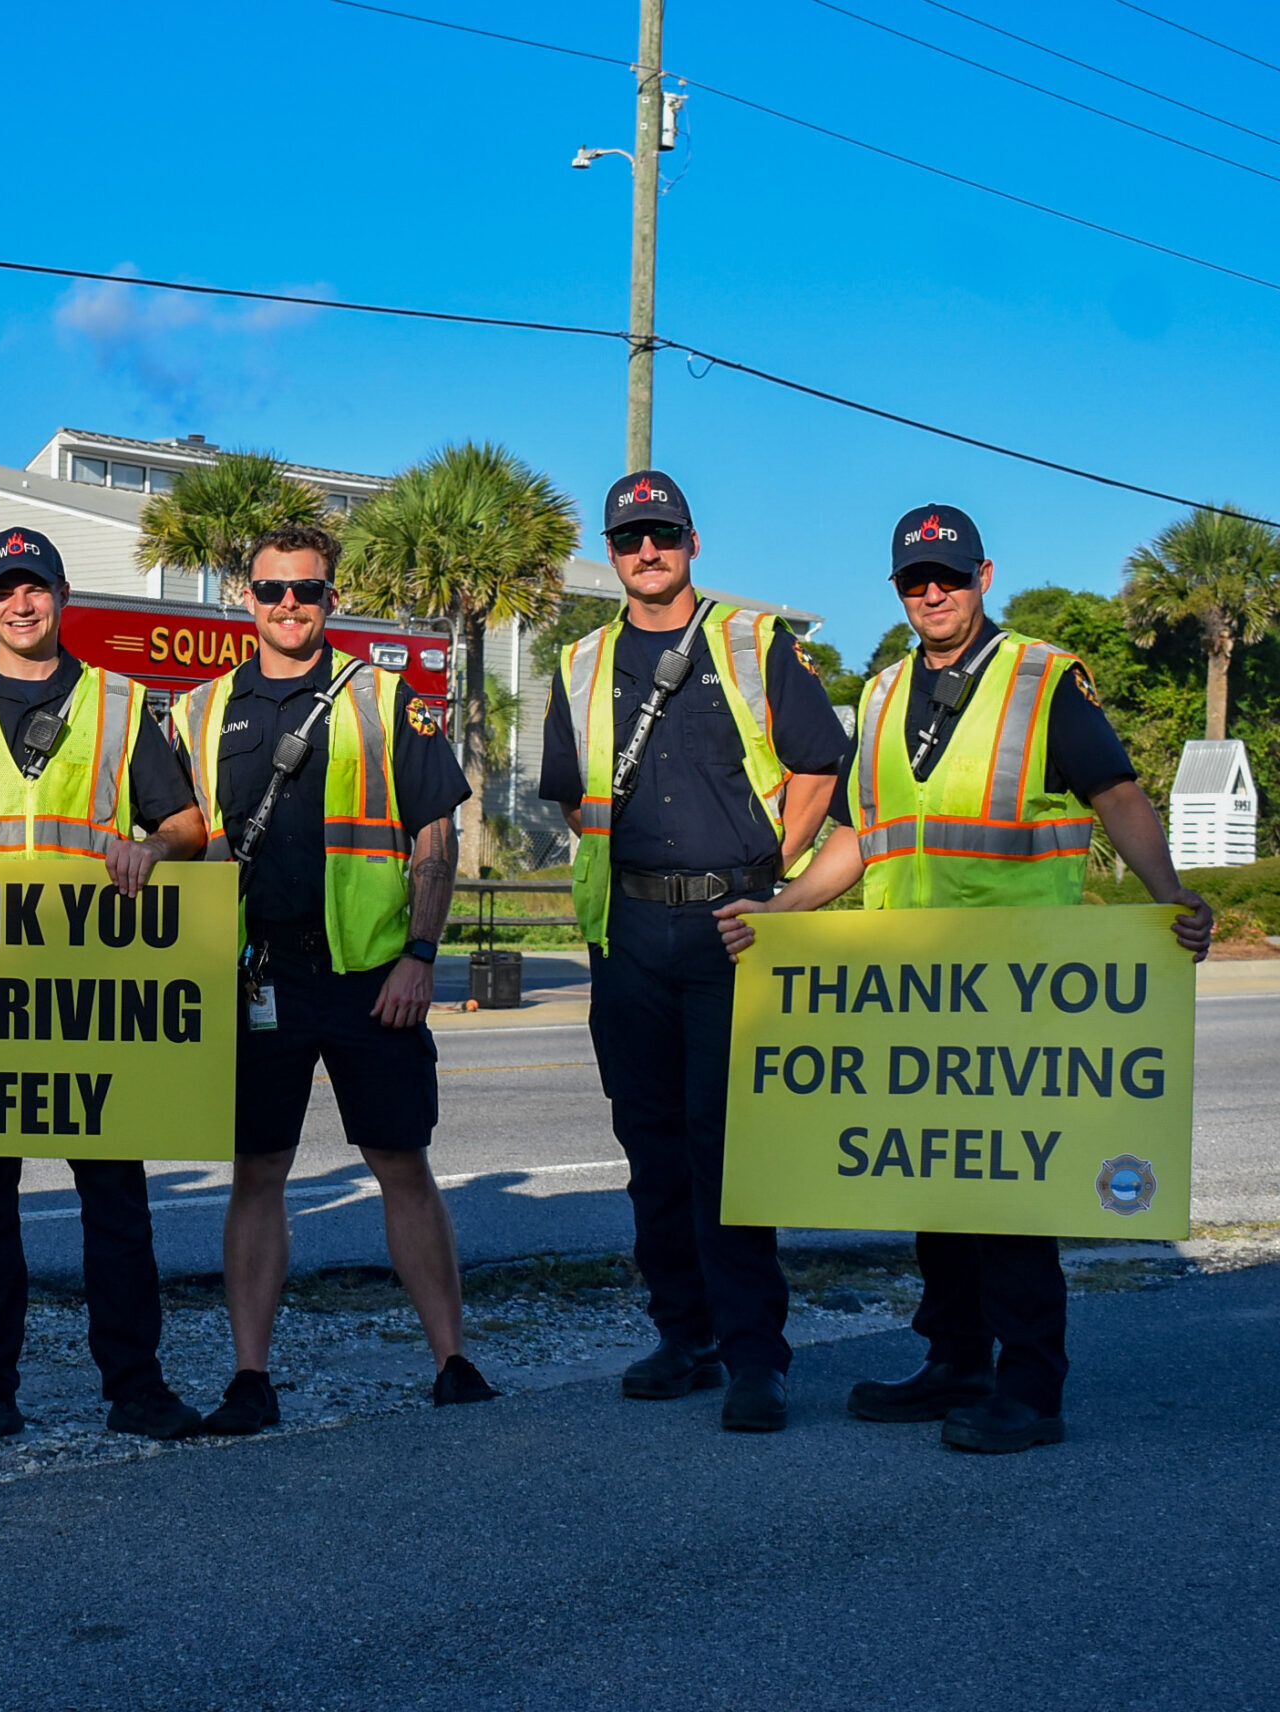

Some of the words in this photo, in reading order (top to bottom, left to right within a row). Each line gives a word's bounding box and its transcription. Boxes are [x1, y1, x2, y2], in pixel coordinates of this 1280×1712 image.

[149, 626, 259, 666] SQUAD
[59, 883, 180, 949] YOU
[772, 963, 989, 1014] THANK
[1007, 962, 1148, 1014] YOU
[753, 1045, 867, 1094] FOR
[888, 1045, 1165, 1099] DRIVING
[837, 1126, 1062, 1181] SAFELY
